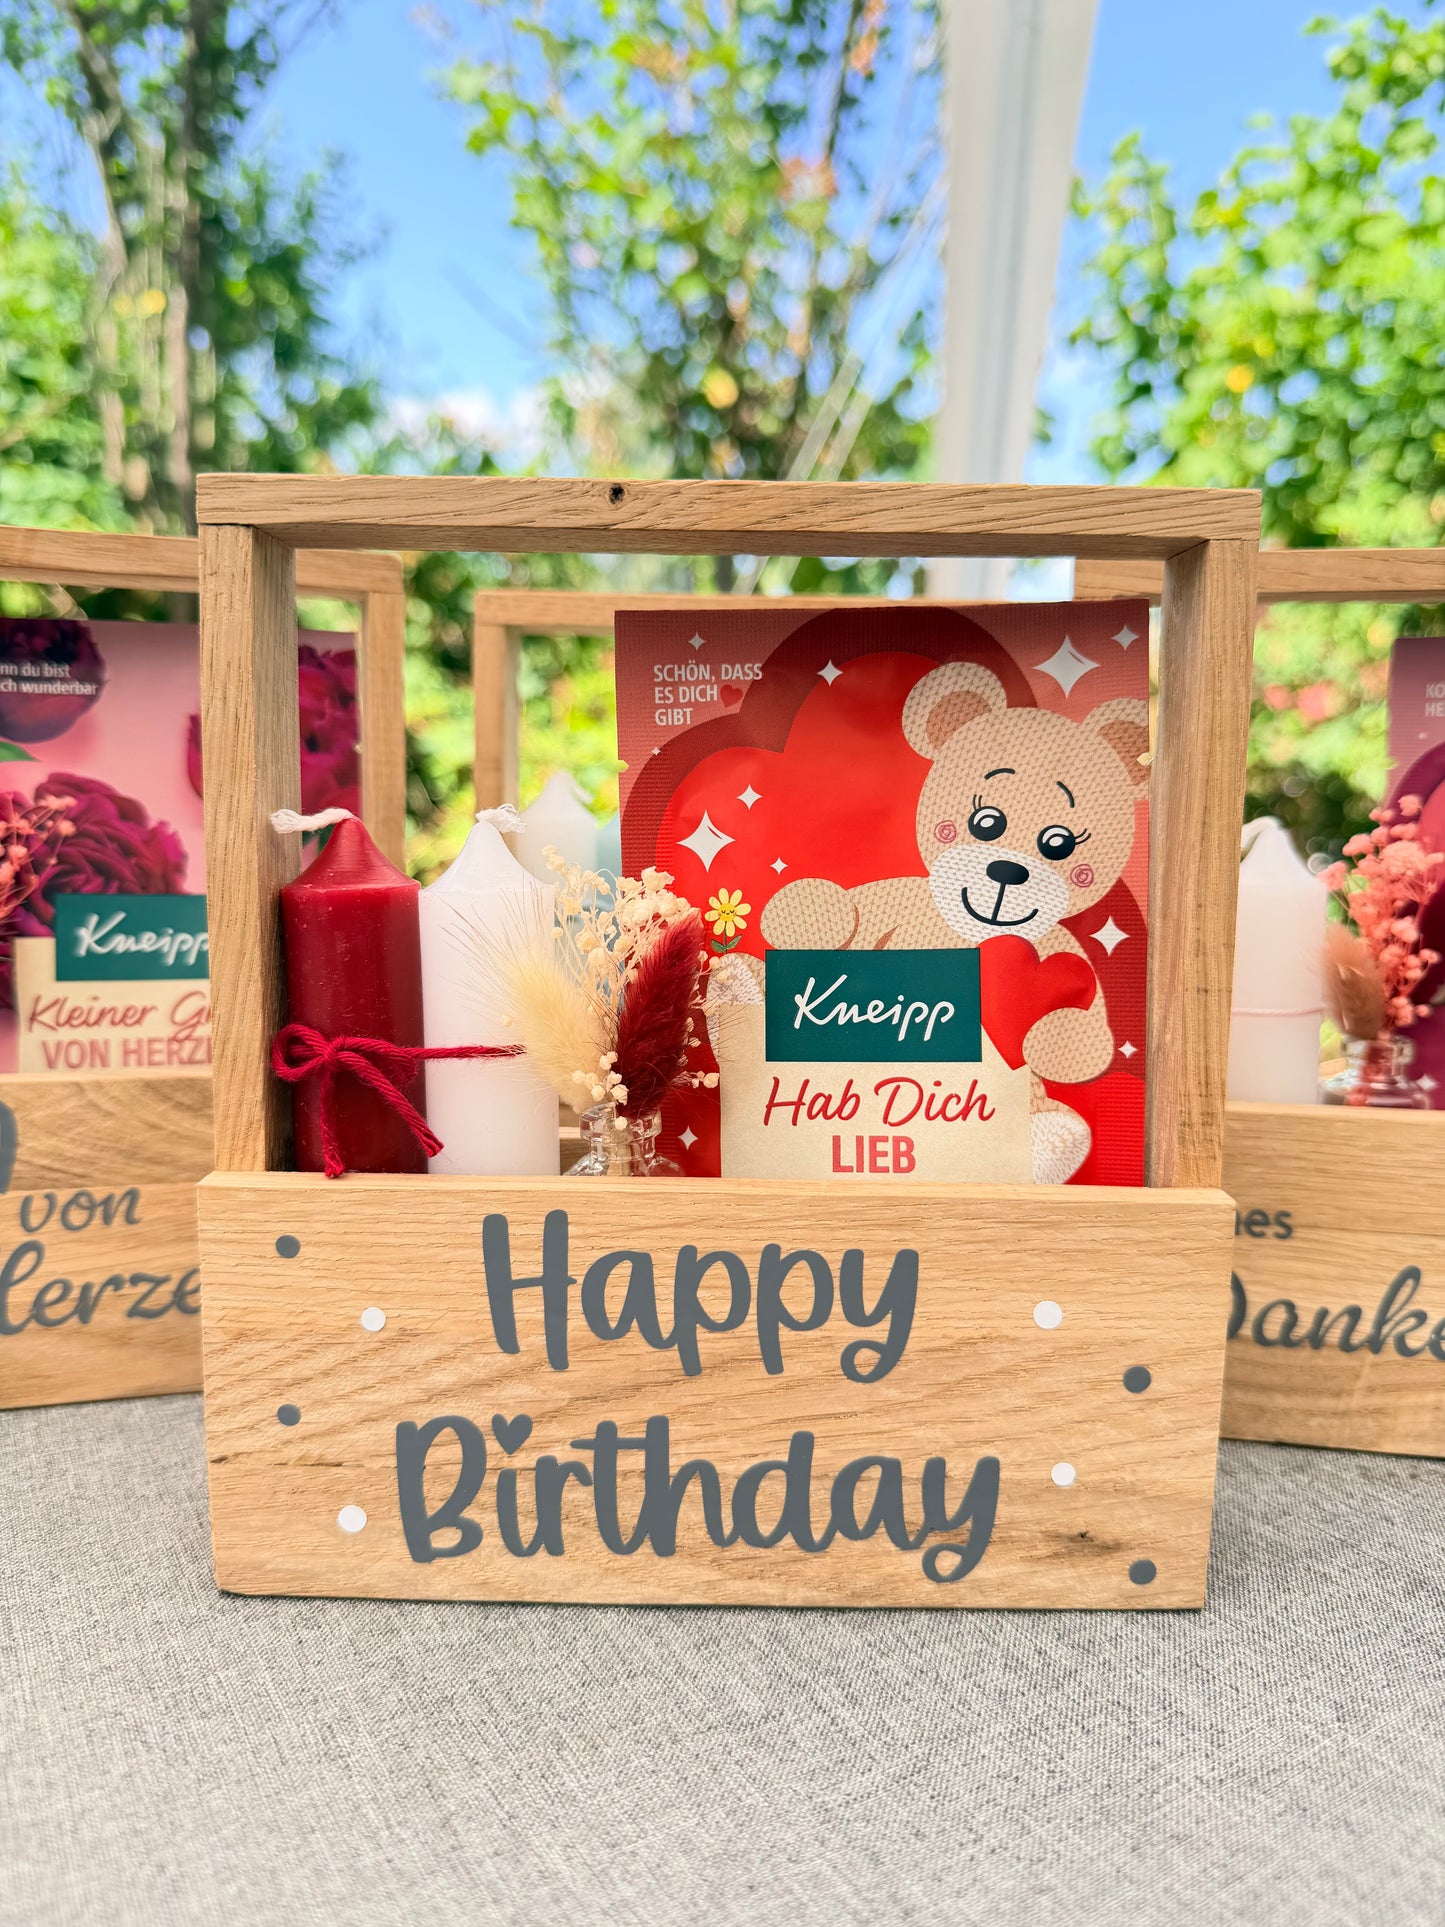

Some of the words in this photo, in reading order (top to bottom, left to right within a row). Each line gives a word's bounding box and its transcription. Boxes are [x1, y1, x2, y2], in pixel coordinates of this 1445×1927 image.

[21, 679, 99, 696] wunderbar
[22, 662, 41, 676] du
[44, 662, 72, 678] bist
[653, 660, 716, 683] SCHÖN,
[721, 663, 763, 681] DASS
[654, 687, 674, 704] ES
[679, 684, 718, 703] DICH
[655, 707, 693, 726] GIBT
[28, 993, 158, 1033] Kleiner
[794, 974, 955, 1042] Kneipp
[42, 1039, 111, 1070] VON
[763, 1076, 861, 1127] Hab
[874, 1076, 996, 1127] Dich
[832, 1134, 917, 1174] LIEB
[19, 1187, 144, 1233] von
[482, 1209, 920, 1384] Happy
[396, 1413, 1001, 1585] Birthday
